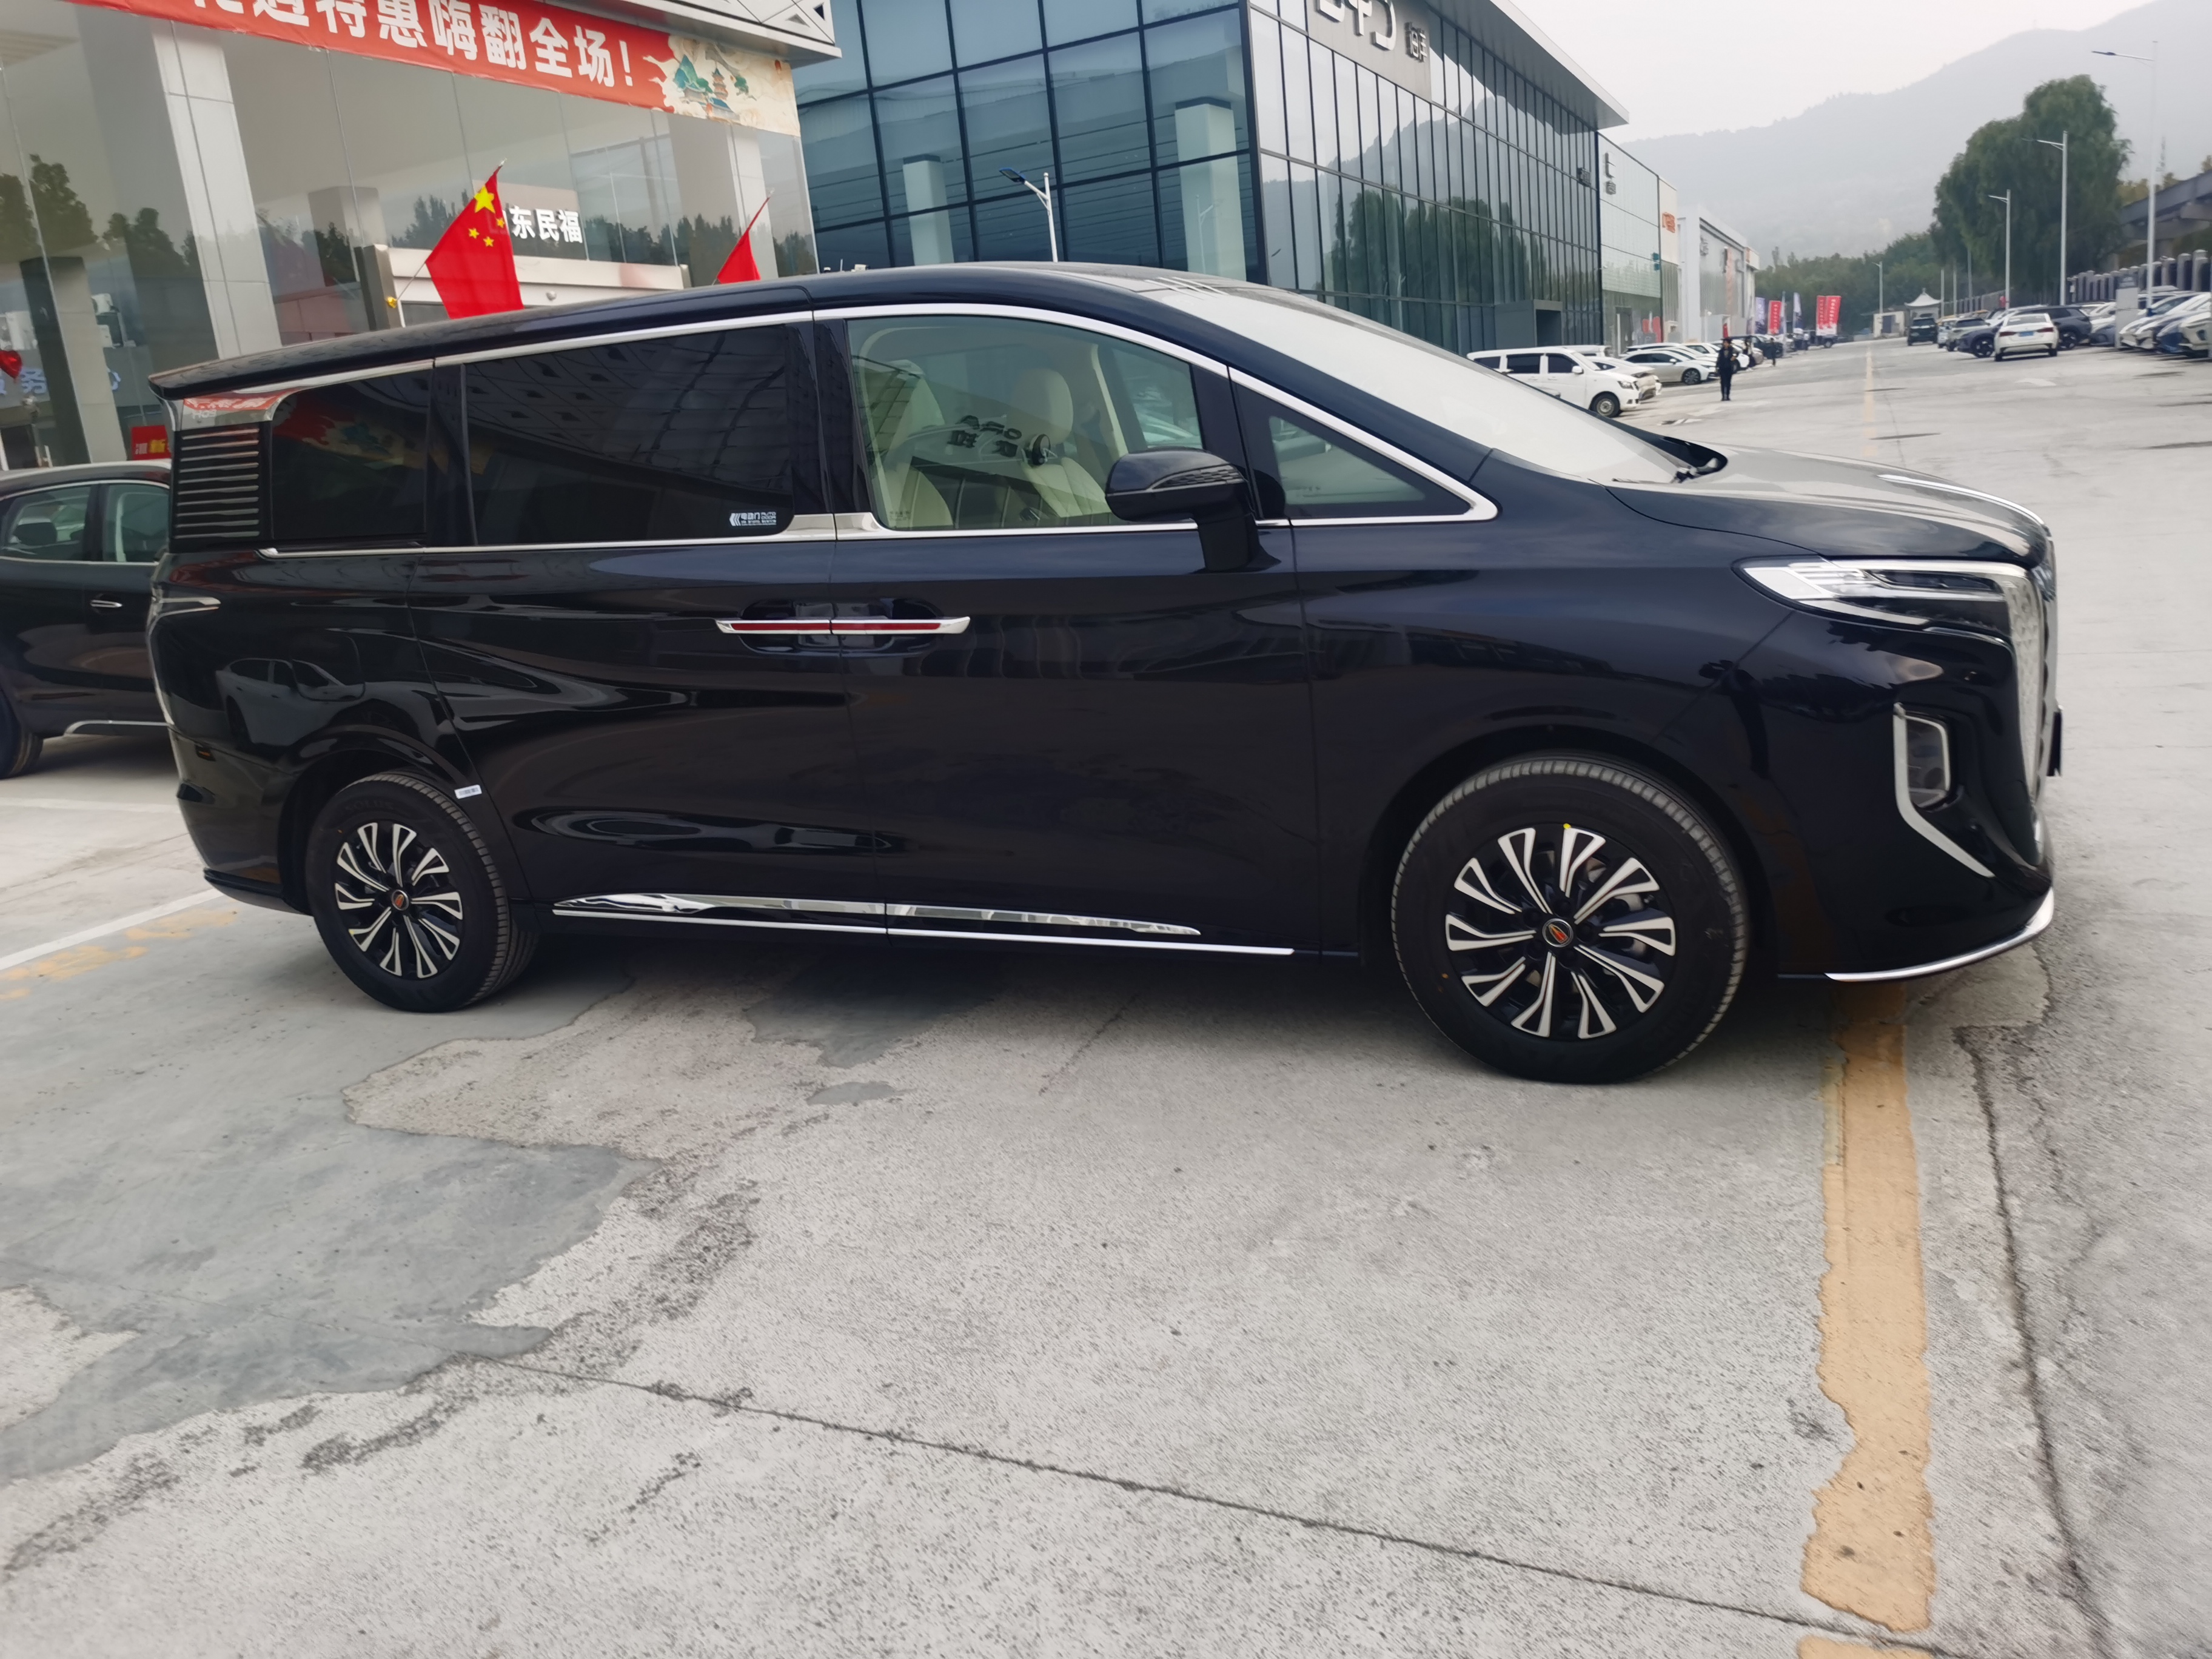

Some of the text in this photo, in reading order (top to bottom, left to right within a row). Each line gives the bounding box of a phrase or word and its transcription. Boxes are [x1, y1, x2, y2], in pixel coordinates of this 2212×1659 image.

[194, 0, 634, 87] 特惠嗨翻全场!
[503, 204, 583, 244] 东民福
